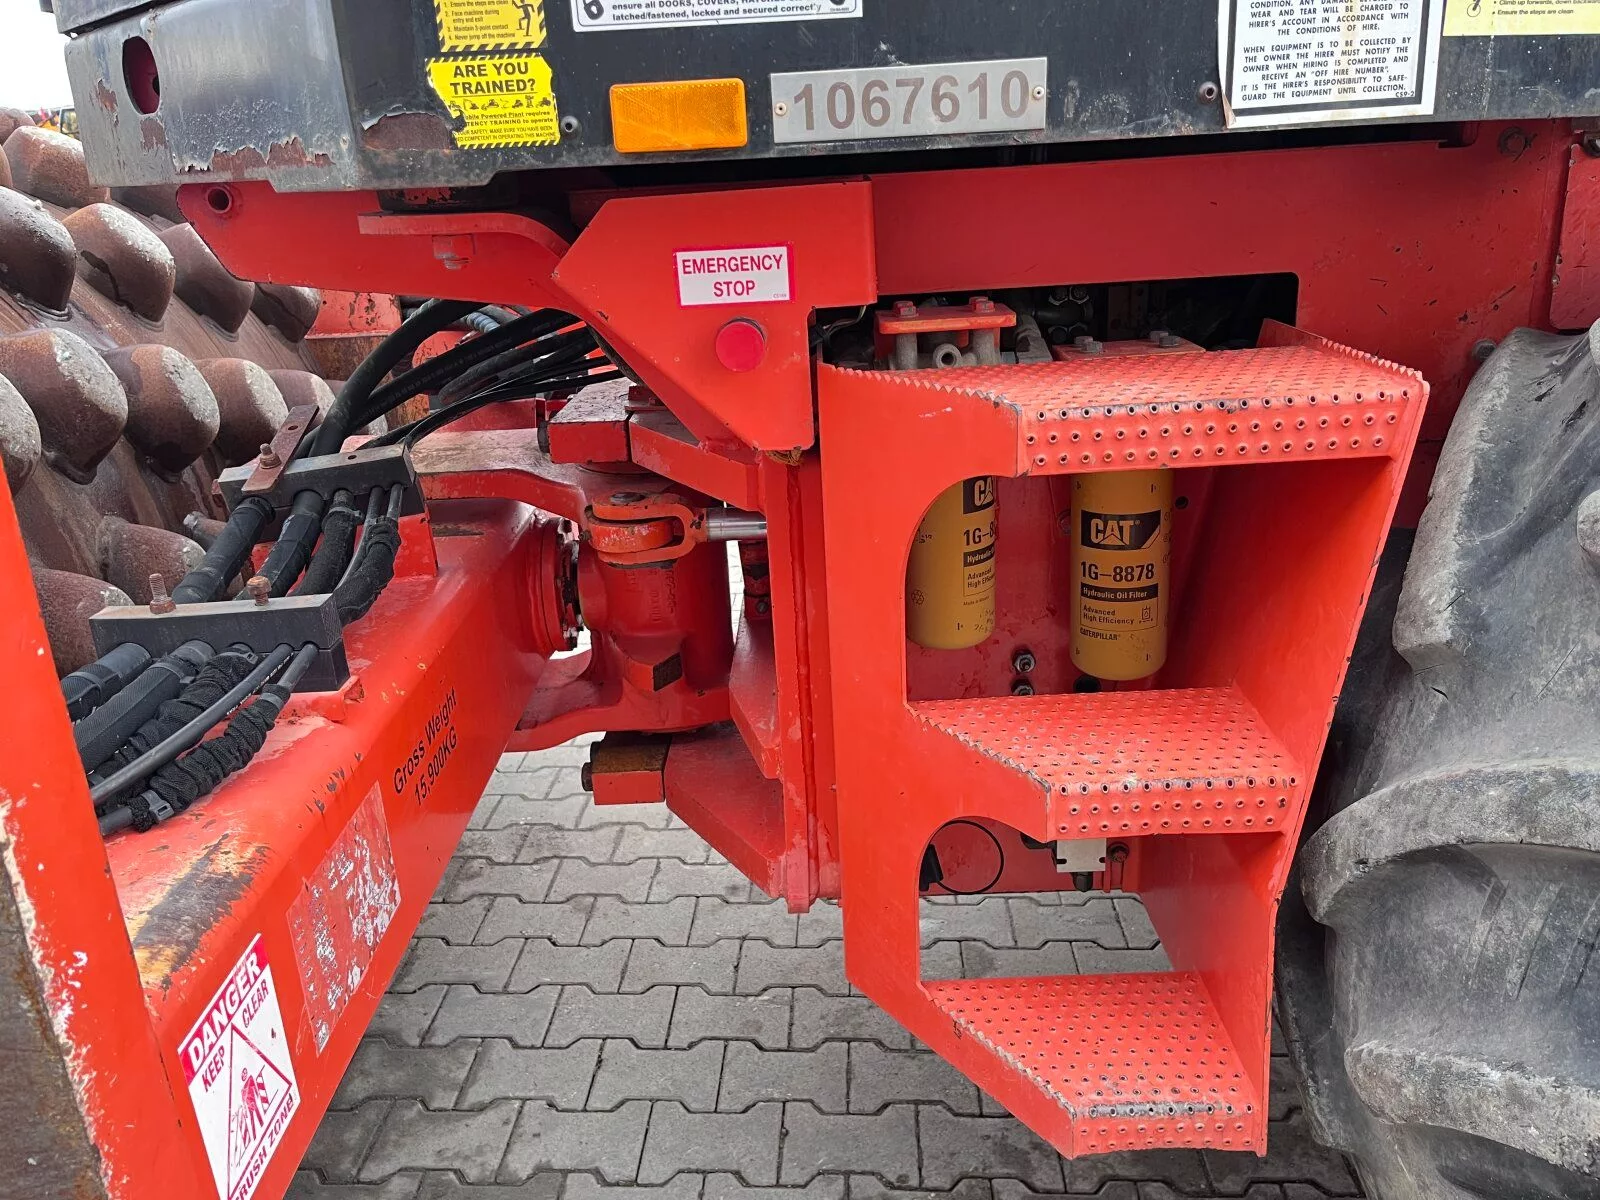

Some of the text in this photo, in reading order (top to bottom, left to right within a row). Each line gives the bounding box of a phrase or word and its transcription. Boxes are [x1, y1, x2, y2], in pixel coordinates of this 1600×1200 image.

[612, 2, 643, 10] ensure
[645, 0, 656, 9] all
[660, 0, 695, 8] DOORS,
[1250, 0, 1293, 9] CONDITION.
[1279, 9, 1295, 17] AND
[1360, 3, 1393, 11] CHARGED
[612, 10, 689, 21] latched/fastened,
[691, 9, 721, 17] locked
[723, 7, 740, 15] and
[742, 5, 778, 14] secured
[1248, 12, 1409, 28] HIRER'S ACCOUNT IN ACCORDANCE WITH
[1296, 25, 1341, 35] CONDITIONS
[1346, 24, 1357, 32] OF
[1362, 23, 1380, 31] HIRE.
[1243, 46, 1265, 54] WHEN
[1271, 42, 1312, 52] EQUIPMENT
[1317, 41, 1324, 49] IS
[1360, 37, 1396, 46] COLLECTED
[1402, 36, 1412, 44] BY
[1244, 55, 1257, 63] THE
[1263, 53, 1290, 61] OWNER
[1296, 52, 1309, 60] THE
[1314, 50, 1335, 58] HIRER
[1340, 48, 1360, 56] MUST
[1365, 47, 1391, 55] NOTIFY
[453, 62, 529, 78] ARE YOU
[1242, 64, 1270, 73] OWNER
[1276, 62, 1298, 70] WHEN
[1302, 60, 1329, 69] HIRING
[1347, 57, 1387, 66] COMPLETED
[1261, 72, 1289, 81] RECEIVE
[1333, 68, 1349, 76] HIRE
[1264, 82, 1277, 90] THE
[1282, 80, 1308, 89] HIRER'S
[1314, 76, 1367, 87] RESPONSIBILITY
[1373, 75, 1382, 83] TO
[1388, 74, 1407, 82] SAFE-
[450, 78, 536, 95] TRAINED?
[1242, 84, 1406, 101] GUARD THE EQUIPMENT UNTIL COLLECTION.
[1395, 90, 1415, 98] CS9-2
[793, 69, 1030, 131] 1067610
[525, 110, 551, 118] requires
[681, 253, 783, 275] EMERGENCY
[713, 280, 755, 298] STOP
[974, 477, 994, 507] CA
[1090, 518, 1134, 546] CAT
[967, 567, 992, 581] Advanced
[1080, 561, 1155, 583] 1G-8878
[967, 579, 981, 588] High
[1083, 587, 1147, 599] Hydraulic Oil Filter
[1083, 604, 1116, 616] Advanced
[1083, 613, 1134, 626] High Efficiency
[1080, 627, 1118, 641] CATERPILLAR
[393, 686, 457, 794] Gross Weight
[414, 725, 457, 806] 15,900KG
[189, 952, 261, 1073] DANGER
[201, 978, 269, 1093] KEEP CLEAR
